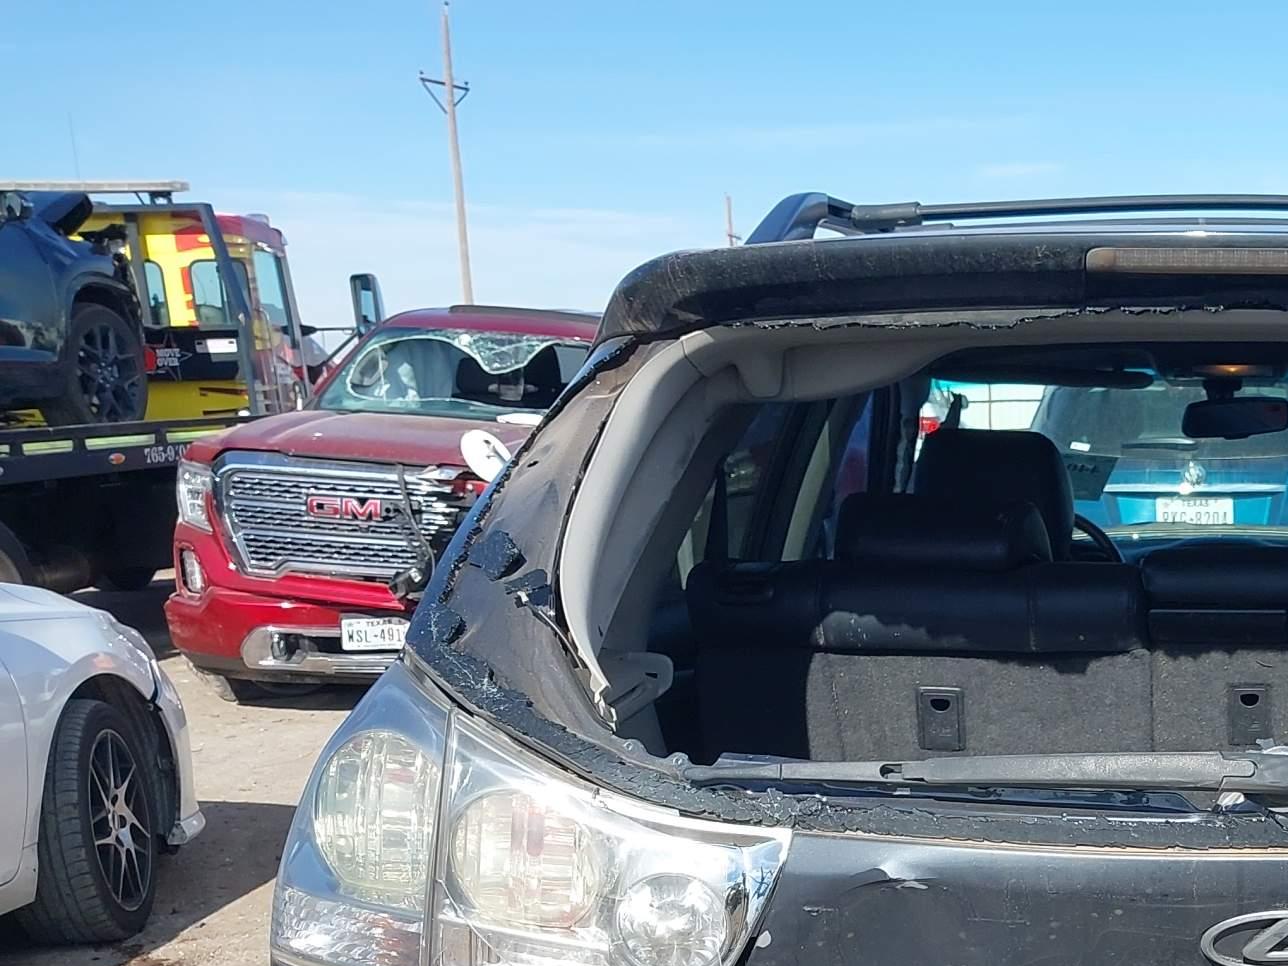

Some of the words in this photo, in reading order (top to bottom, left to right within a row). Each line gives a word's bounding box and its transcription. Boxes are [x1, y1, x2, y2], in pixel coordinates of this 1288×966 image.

[156, 357, 180, 367] OVER
[307, 496, 381, 521] GM
[347, 627, 405, 643] WSL-491
